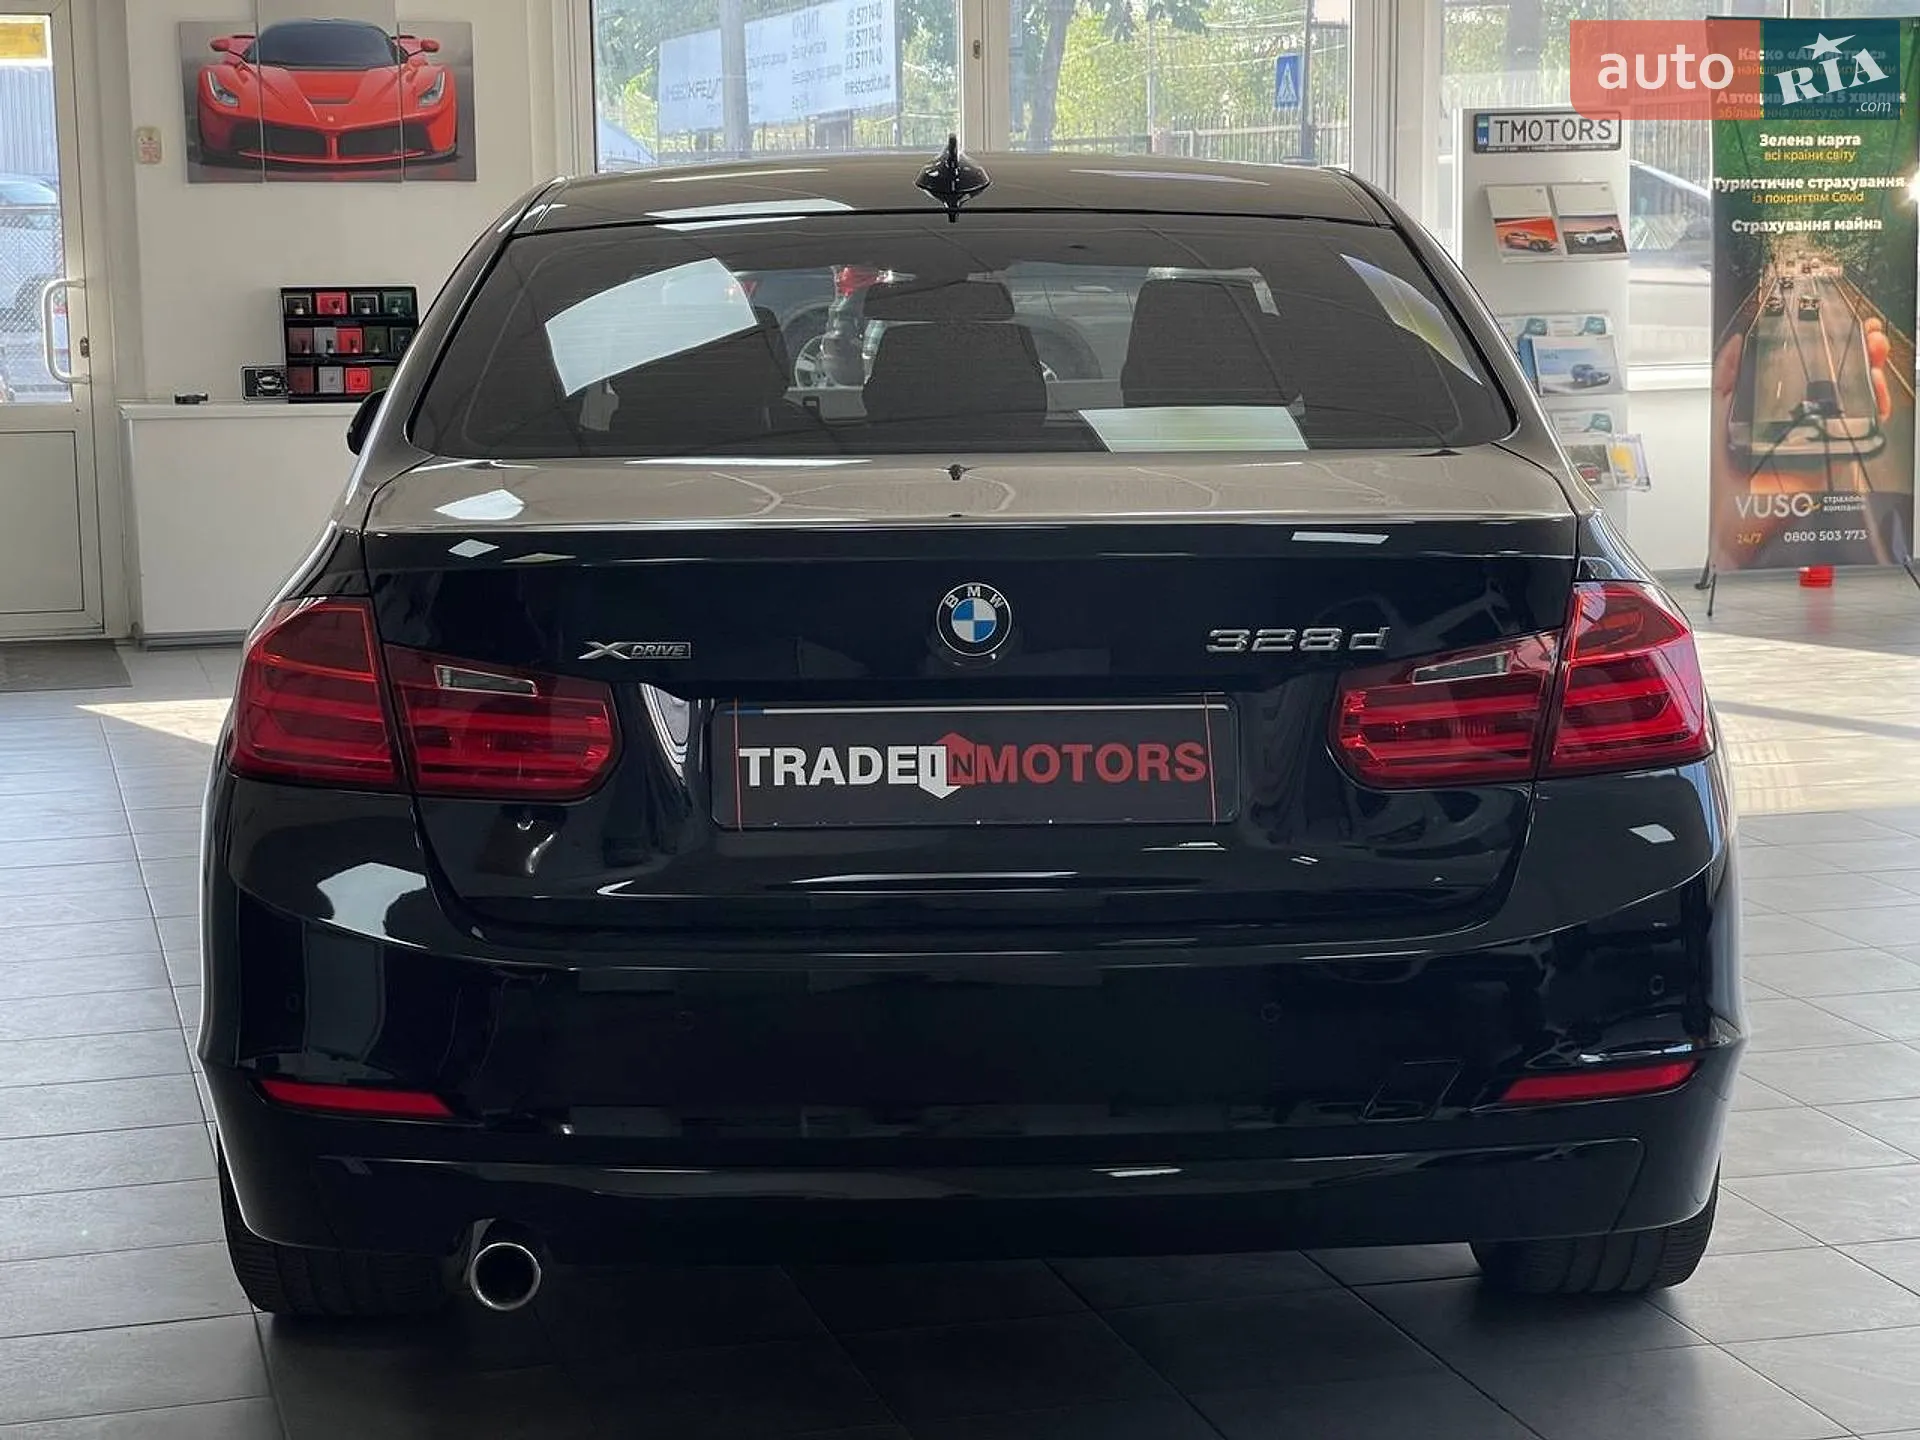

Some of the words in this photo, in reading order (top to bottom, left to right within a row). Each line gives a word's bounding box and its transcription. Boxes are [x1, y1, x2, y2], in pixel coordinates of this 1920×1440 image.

[1836, 91, 1847, 103] 5
[1494, 118, 1612, 143] TMOTORS
[1759, 134, 1813, 147] Зелена
[1817, 135, 1861, 149] карта
[1764, 150, 1781, 161] всі
[1783, 150, 1823, 162] країни
[1826, 150, 1856, 162] світу
[1714, 177, 1804, 192] Туристичне
[1807, 176, 1905, 191] страхування
[1752, 193, 1762, 204] із
[1765, 194, 1829, 205] покриттям
[1833, 191, 1864, 202] Covid
[1731, 218, 1831, 234] Страхування
[1834, 216, 1882, 231] майна
[1735, 492, 1814, 519] VUSO
[1737, 532, 1762, 544] 24/7
[1783, 531, 1817, 543] 0800
[1819, 530, 1842, 542] 503
[1844, 529, 1868, 541] 773
[944, 586, 1004, 609] BMW
[1205, 626, 1391, 651] 328d
